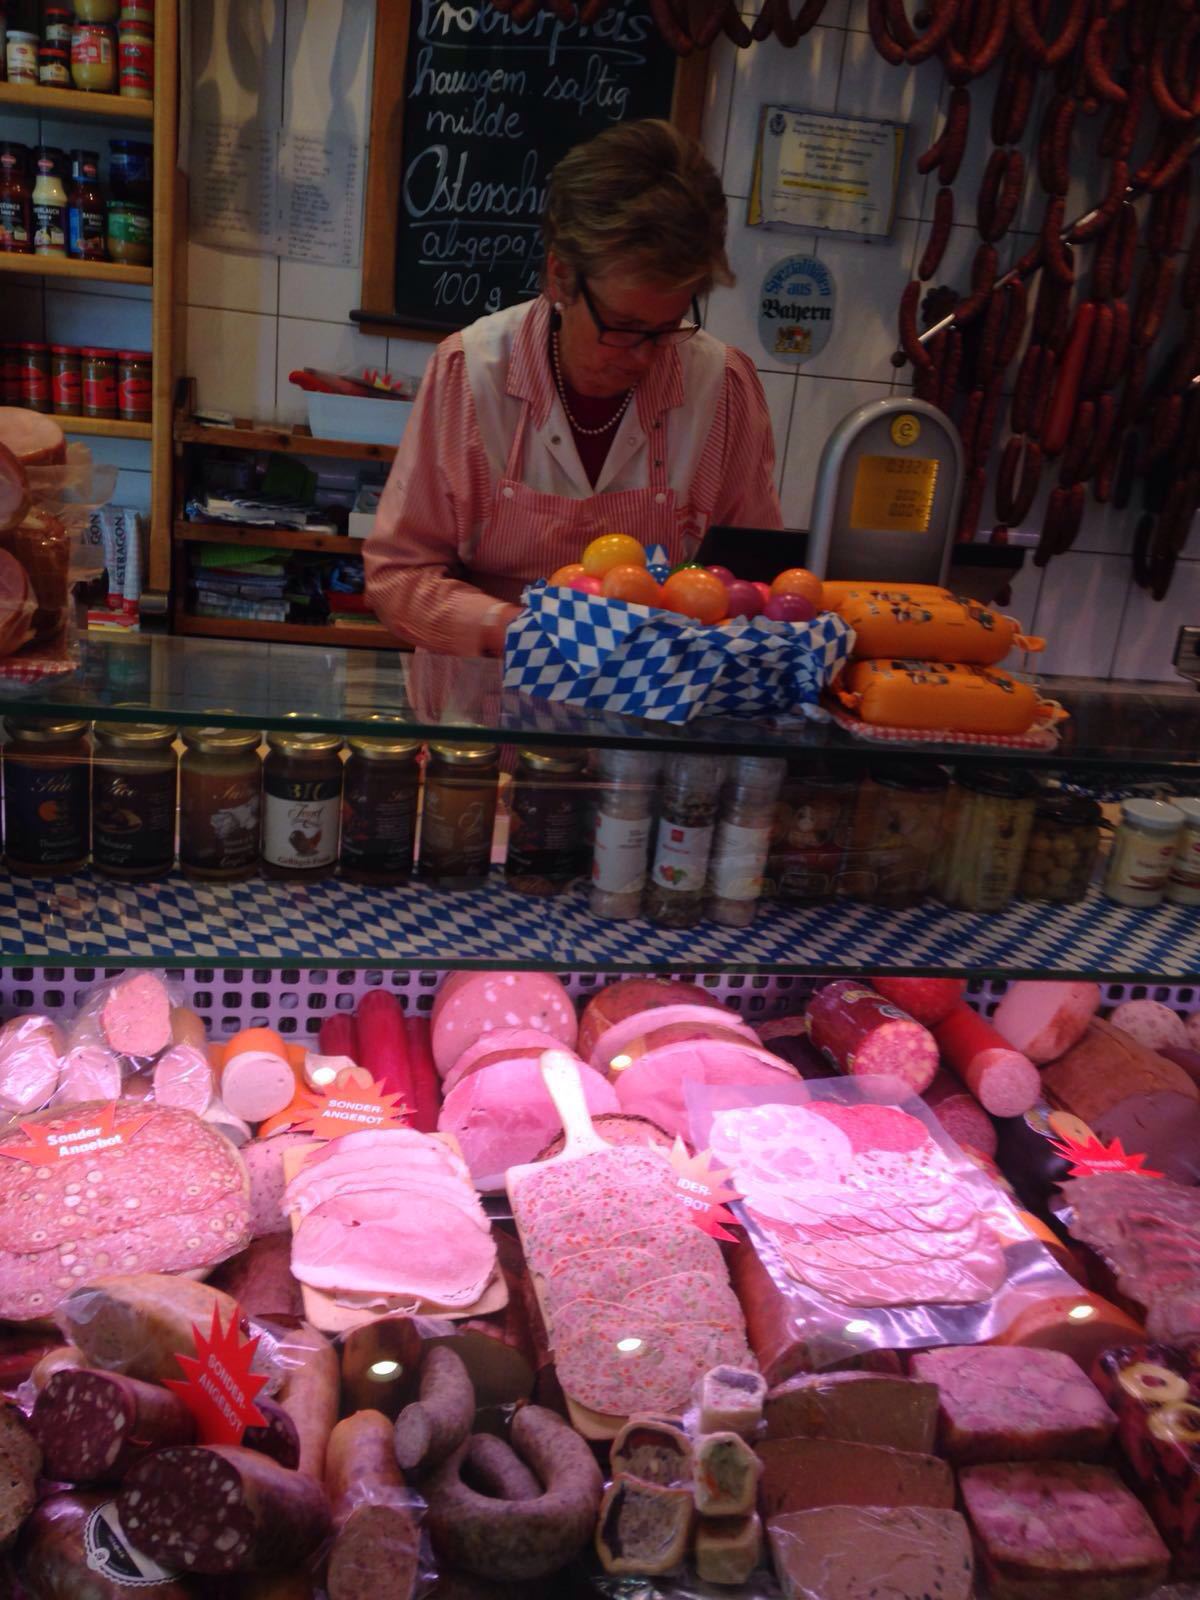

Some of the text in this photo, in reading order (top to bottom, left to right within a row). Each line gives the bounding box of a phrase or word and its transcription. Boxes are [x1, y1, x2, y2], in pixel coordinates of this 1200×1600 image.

[543, 54, 631, 120] saftig
[426, 100, 524, 138] milde
[403, 144, 549, 218] Osterschi
[432, 271, 503, 312] 100 g
[786, 282, 812, 297] aus
[761, 298, 832, 323] Bayern
[114, 516, 127, 586] ESTRAGON
[321, 1109, 384, 1125] ANGEBOT
[46, 1127, 102, 1147] Sonder
[58, 1134, 122, 1157] Angebot
[198, 1372, 243, 1433] ANGEBOT
